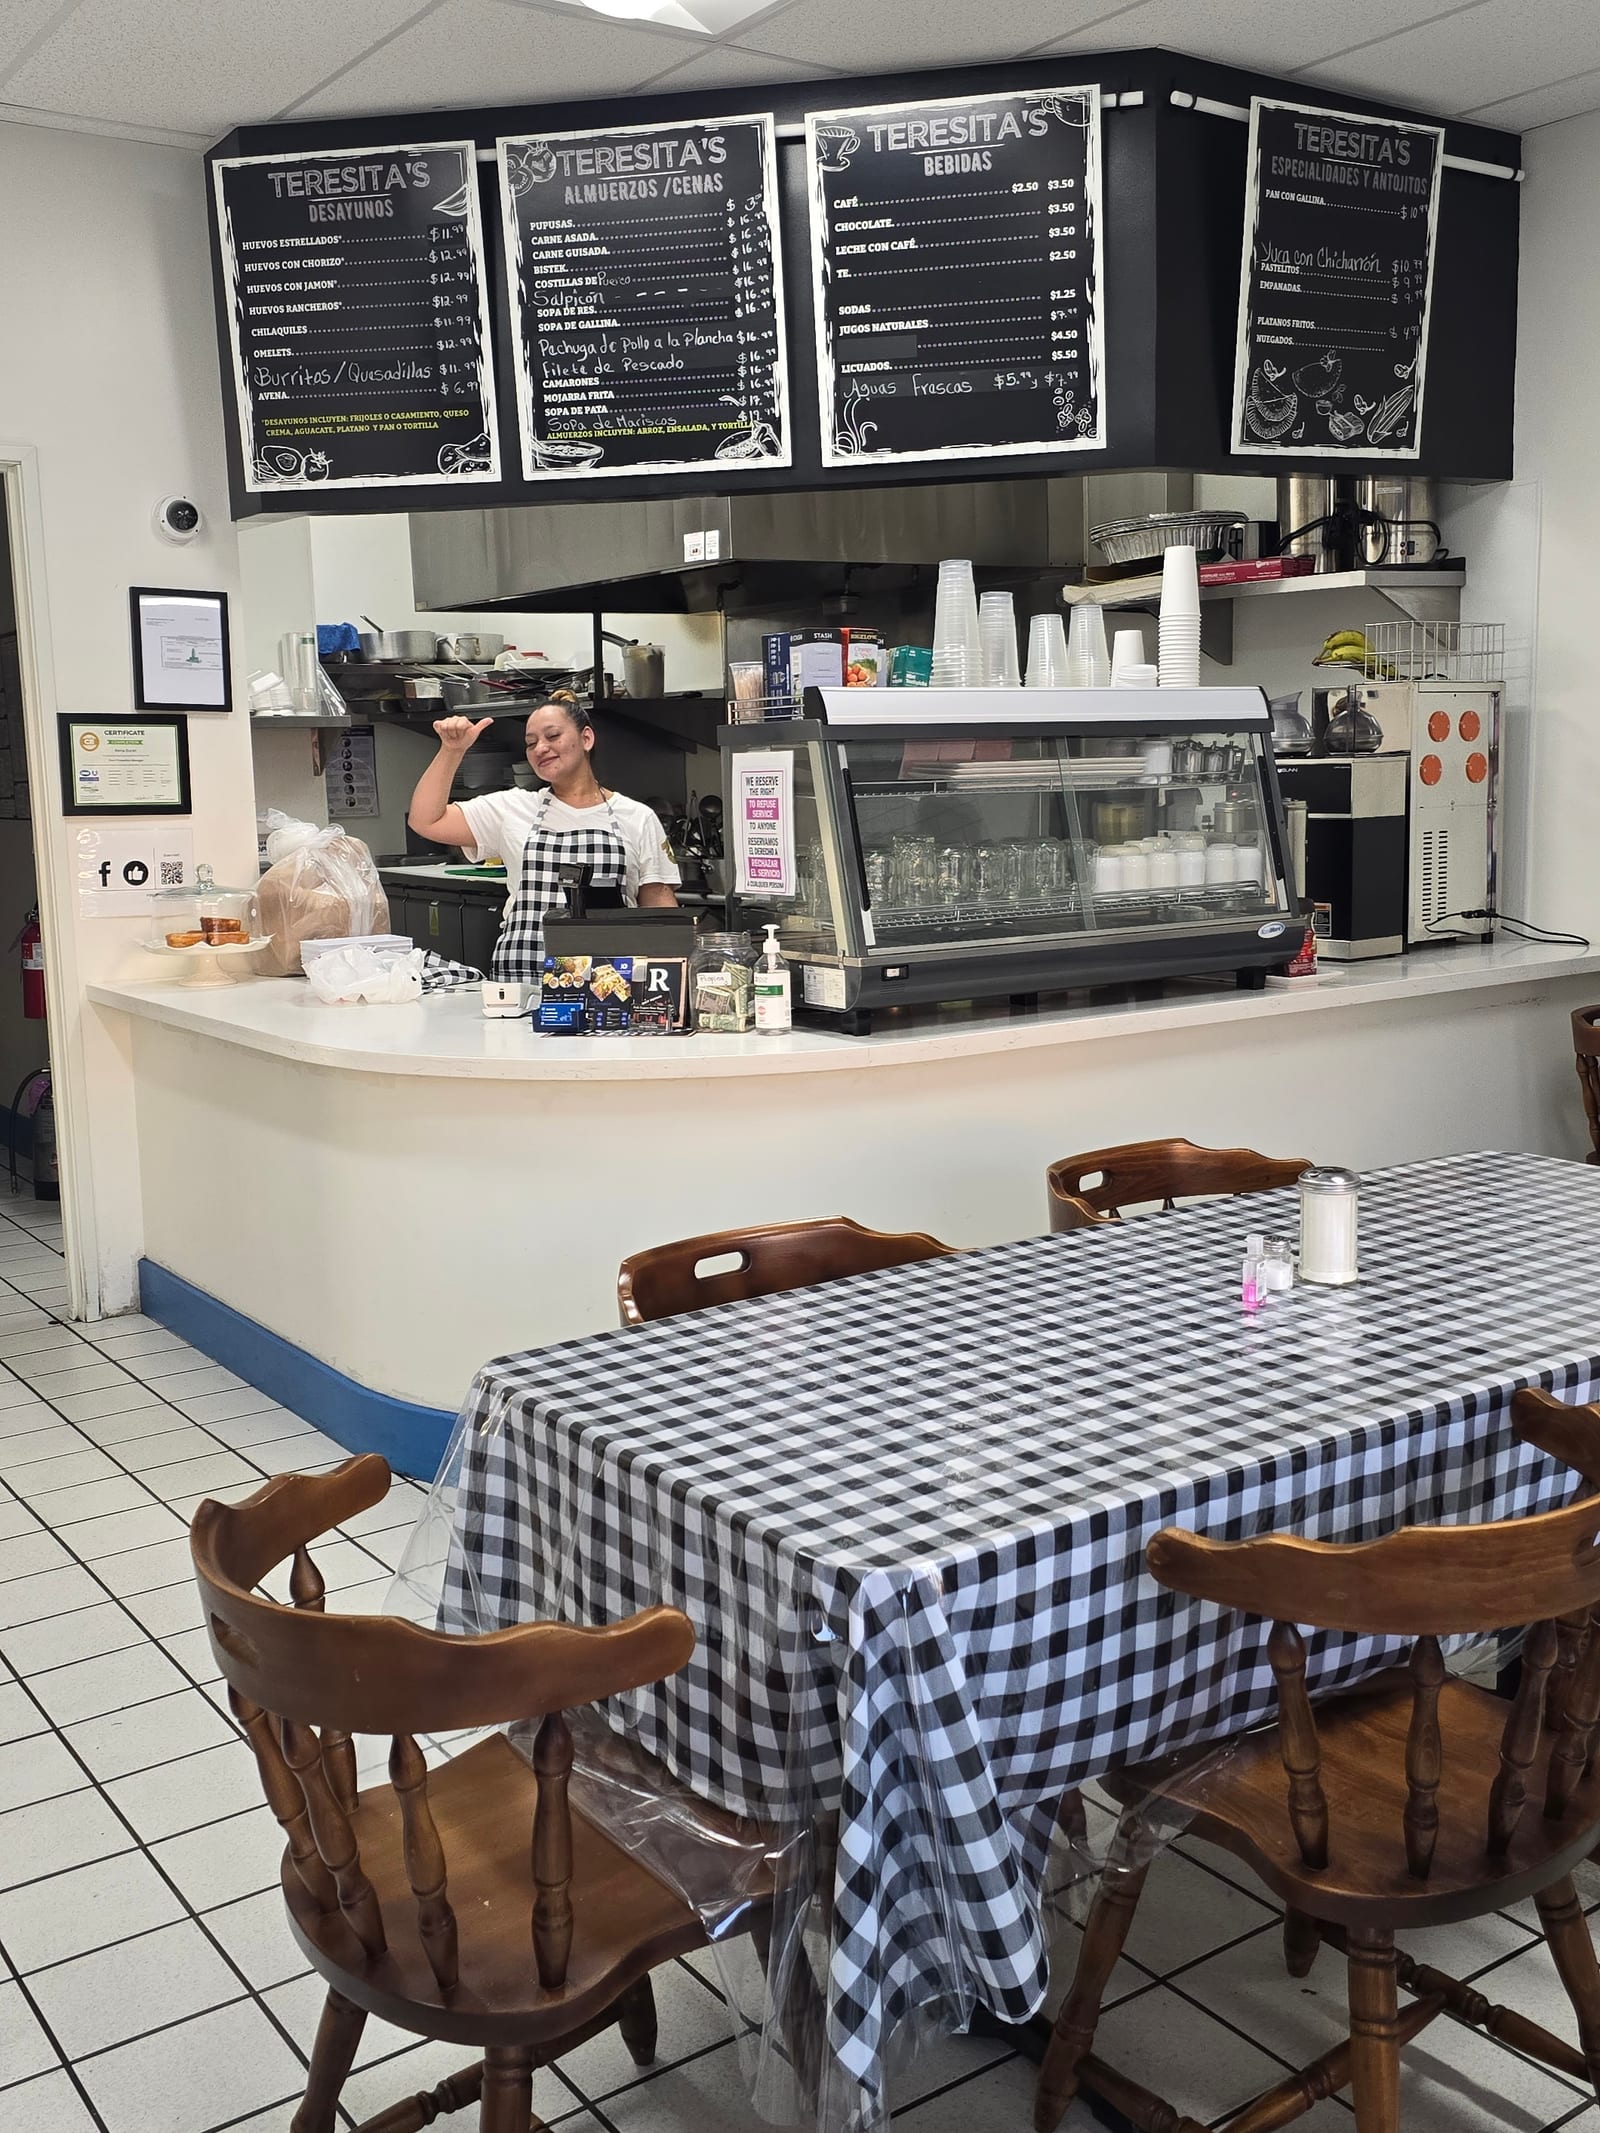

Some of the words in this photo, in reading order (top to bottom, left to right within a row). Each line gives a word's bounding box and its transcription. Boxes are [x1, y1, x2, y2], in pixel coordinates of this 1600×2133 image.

[867, 109, 1048, 153] TERESITA'S
[1294, 122, 1410, 165] TERESITA'S
[556, 136, 726, 176] TERESITA'S
[924, 151, 992, 176] BEBIDAS
[268, 161, 430, 199] TERESITA'S
[1272, 155, 1359, 186] ESPECIALIDADES
[1363, 169, 1370, 187] Y
[1372, 171, 1427, 196] ANTOJITOS
[565, 178, 658, 205] ALMUERZOS
[833, 196, 859, 209] CAFÉ
[1012, 181, 1039, 194] $2.50
[1048, 178, 1074, 190] $3.50
[1265, 189, 1280, 198] PAN
[1281, 192, 1295, 201] CON
[309, 199, 393, 223] DESAYUNOS
[1048, 202, 1075, 214] $3.50
[242, 239, 278, 251] HUEVOS
[531, 235, 562, 245] CARNE
[836, 243, 866, 255] LECHE
[868, 242, 889, 253] CON
[1048, 226, 1075, 238] $3.50
[533, 249, 564, 260] CARNE
[1049, 250, 1076, 262] $2.50
[1294, 249, 1313, 267] con
[245, 261, 280, 272] HUEVOS
[282, 260, 299, 269] CON
[1261, 263, 1299, 274] PASTELITOS
[247, 283, 282, 294] HUEVOS
[284, 281, 302, 292] CON
[535, 278, 583, 289] COSTILLAS
[585, 276, 598, 286] DE
[839, 304, 871, 315] SODAS
[1050, 289, 1076, 301] $1.25
[249, 305, 284, 316] HUEVOS
[537, 308, 559, 317] SOPA
[560, 307, 573, 316] DE
[538, 322, 560, 331] SOPA
[561, 322, 577, 330] DE
[839, 324, 870, 336] JUGOS
[872, 319, 929, 332] NATURALES
[1257, 317, 1291, 327] PLATANOS
[251, 325, 307, 337] CHILAQUILES
[1051, 330, 1078, 341] $4.50
[600, 334, 616, 352] de
[654, 337, 663, 348] a
[667, 331, 680, 347] la
[1052, 350, 1078, 361] $5.50
[594, 357, 614, 374] de
[543, 377, 600, 388] CAMARONES
[843, 378, 897, 399] Aguas
[544, 392, 584, 403] MOJARRA
[585, 390, 615, 400] FRITA
[350, 412, 382, 423] FRIJOLES
[384, 412, 389, 421] O
[443, 408, 469, 418] QUESO
[545, 407, 566, 416] SOPA
[583, 405, 608, 414] PATA
[337, 424, 370, 433] PLATANO
[373, 423, 378, 431] Y
[379, 423, 395, 431] PAN
[404, 421, 439, 430] TORTILLA
[593, 415, 612, 429] de
[547, 429, 593, 439] ALMUERZOS
[711, 423, 717, 431] Y
[813, 632, 833, 640] STASH
[648, 968, 670, 992] R
